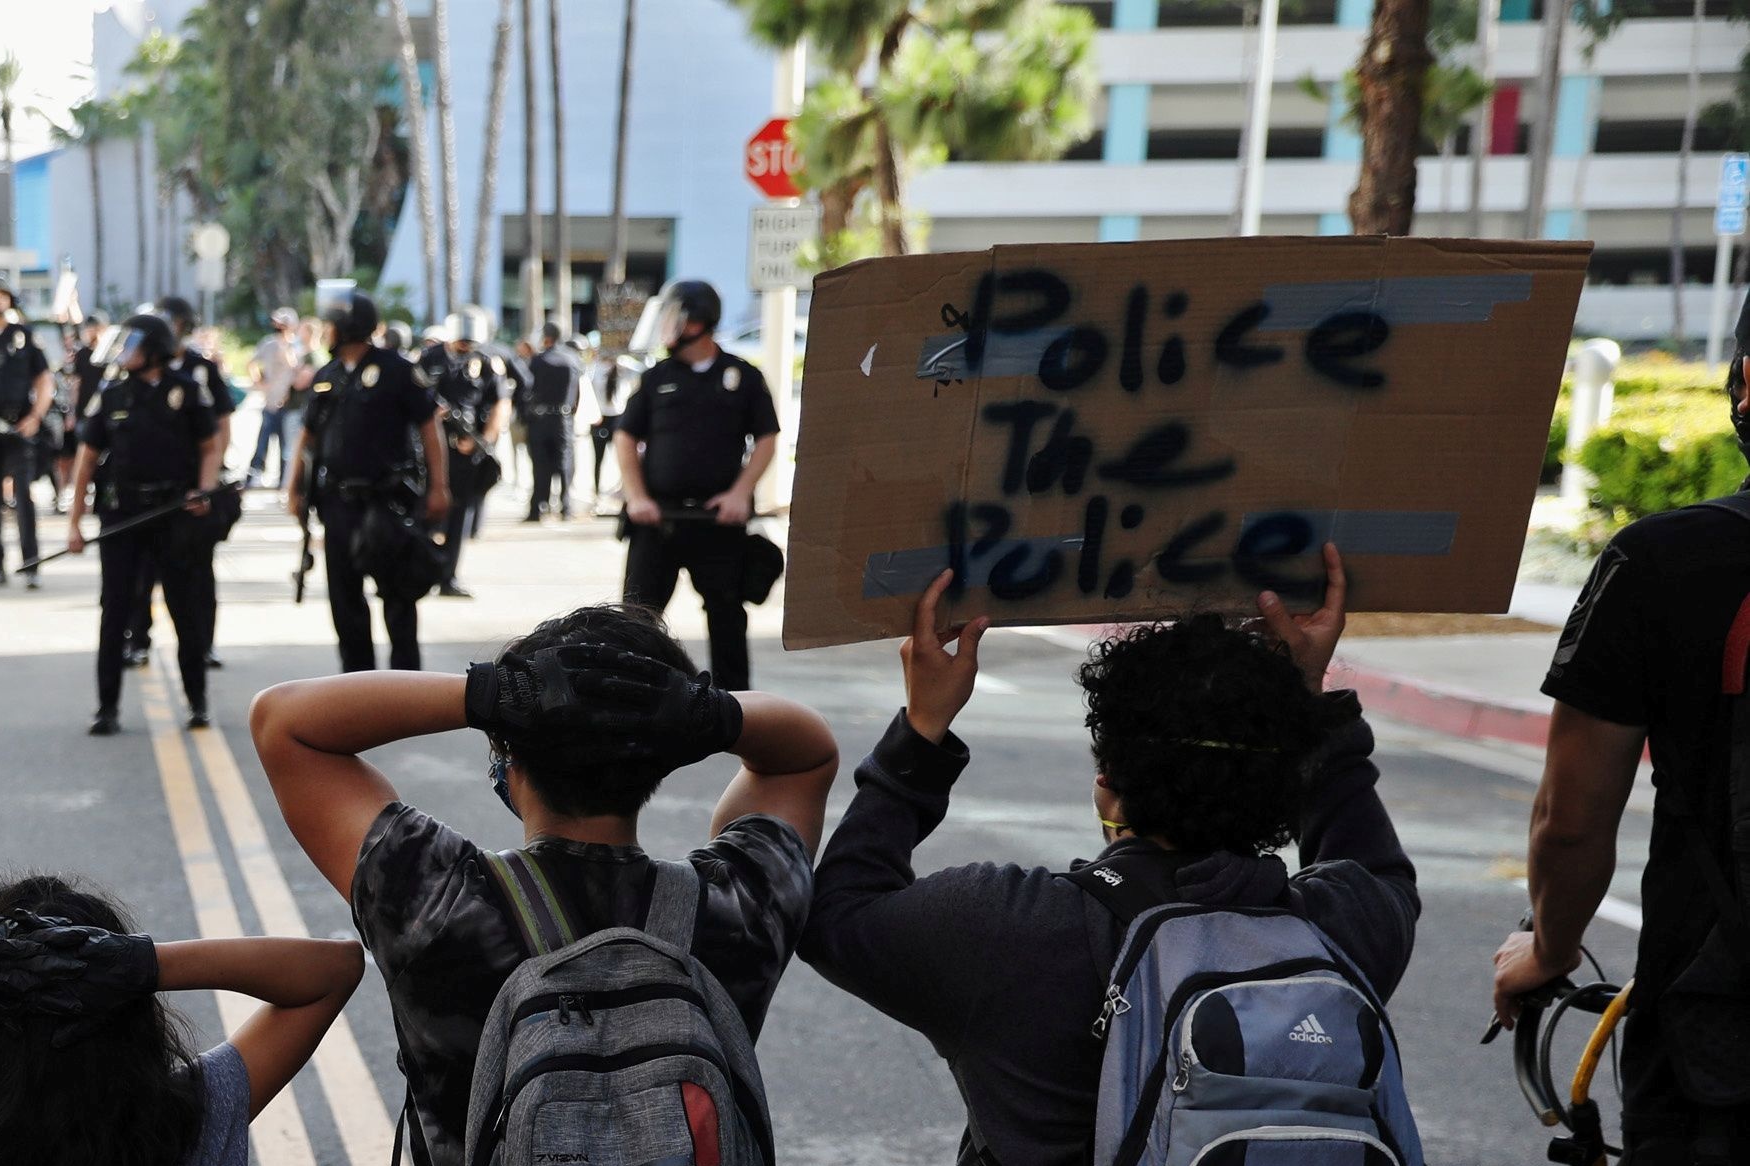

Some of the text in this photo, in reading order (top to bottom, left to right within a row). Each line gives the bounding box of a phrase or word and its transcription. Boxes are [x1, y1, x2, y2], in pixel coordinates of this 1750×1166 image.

[747, 139, 806, 177] STO
[962, 267, 1395, 391] Police
[981, 400, 1237, 496] The
[943, 497, 1338, 600] Police
[514, 671, 533, 706] echanix
[1289, 1031, 1333, 1044] adidas
